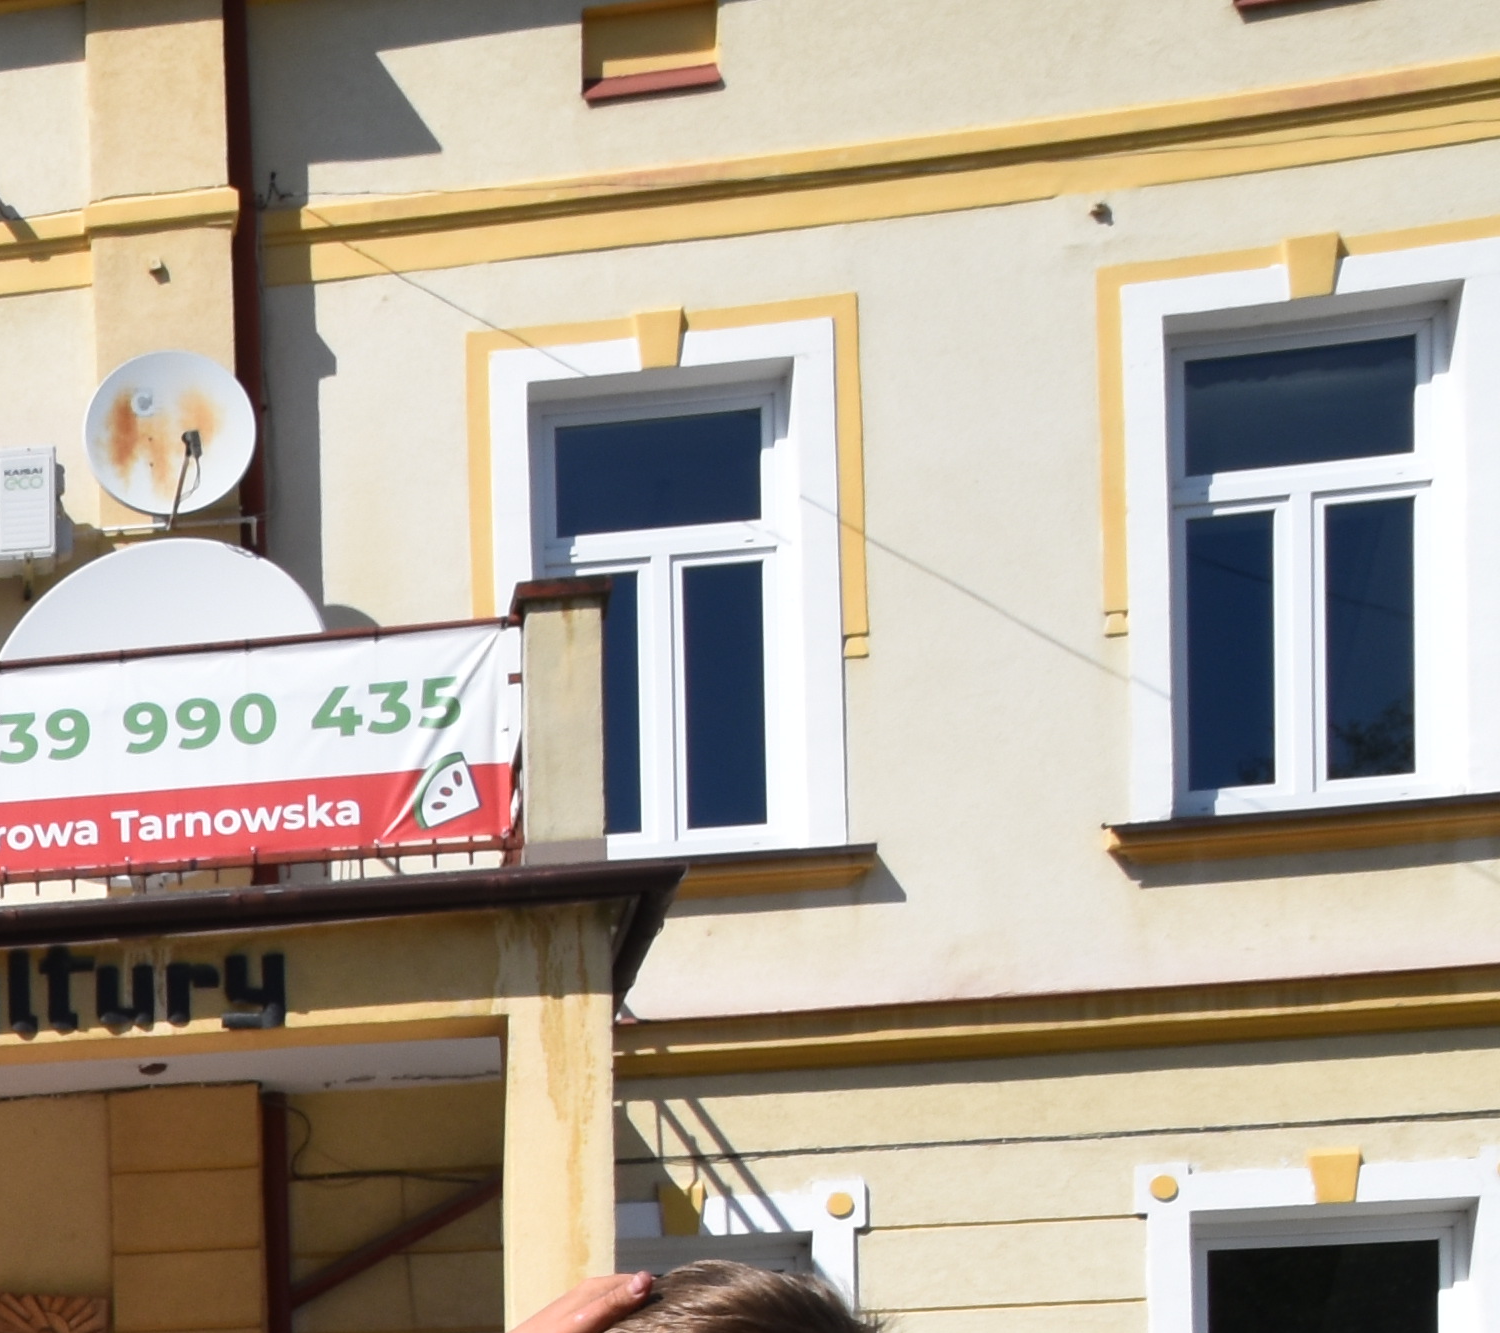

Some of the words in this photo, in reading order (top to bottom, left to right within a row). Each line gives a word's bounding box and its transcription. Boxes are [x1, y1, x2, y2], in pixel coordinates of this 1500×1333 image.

[4, 475, 43, 491] eco
[122, 693, 278, 755] 990
[312, 676, 462, 737] 435
[112, 796, 361, 843] Tarnowska
